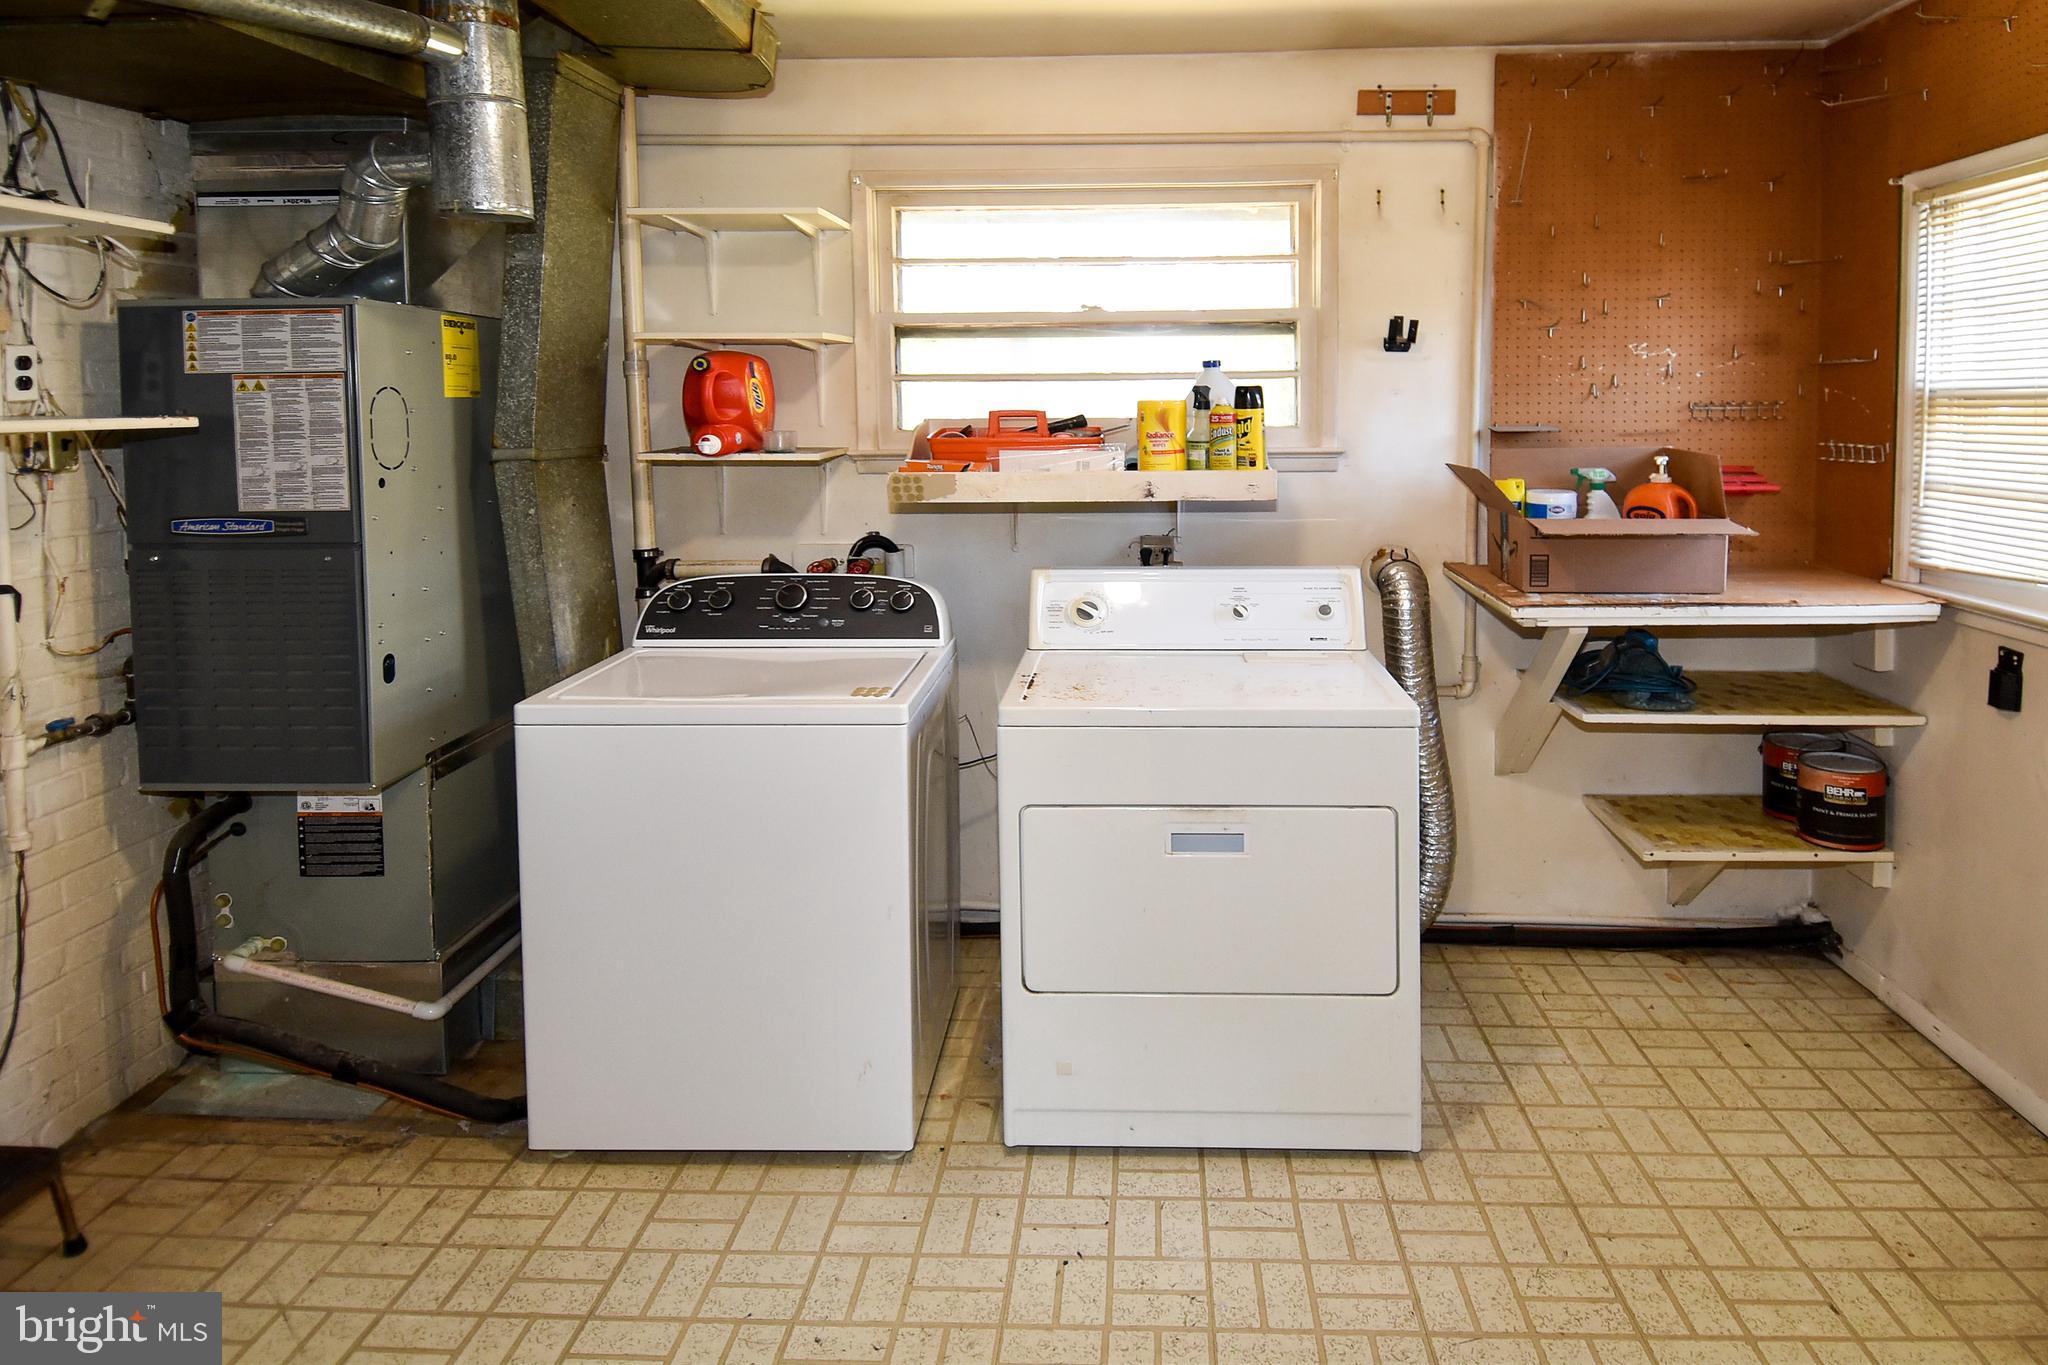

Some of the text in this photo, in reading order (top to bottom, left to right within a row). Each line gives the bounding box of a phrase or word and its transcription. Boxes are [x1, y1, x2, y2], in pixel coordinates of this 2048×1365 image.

[180, 521, 220, 531] American
[223, 521, 266, 531] Standard
[645, 626, 676, 635] Whirlpool
[1826, 786, 1855, 797] BEHR
